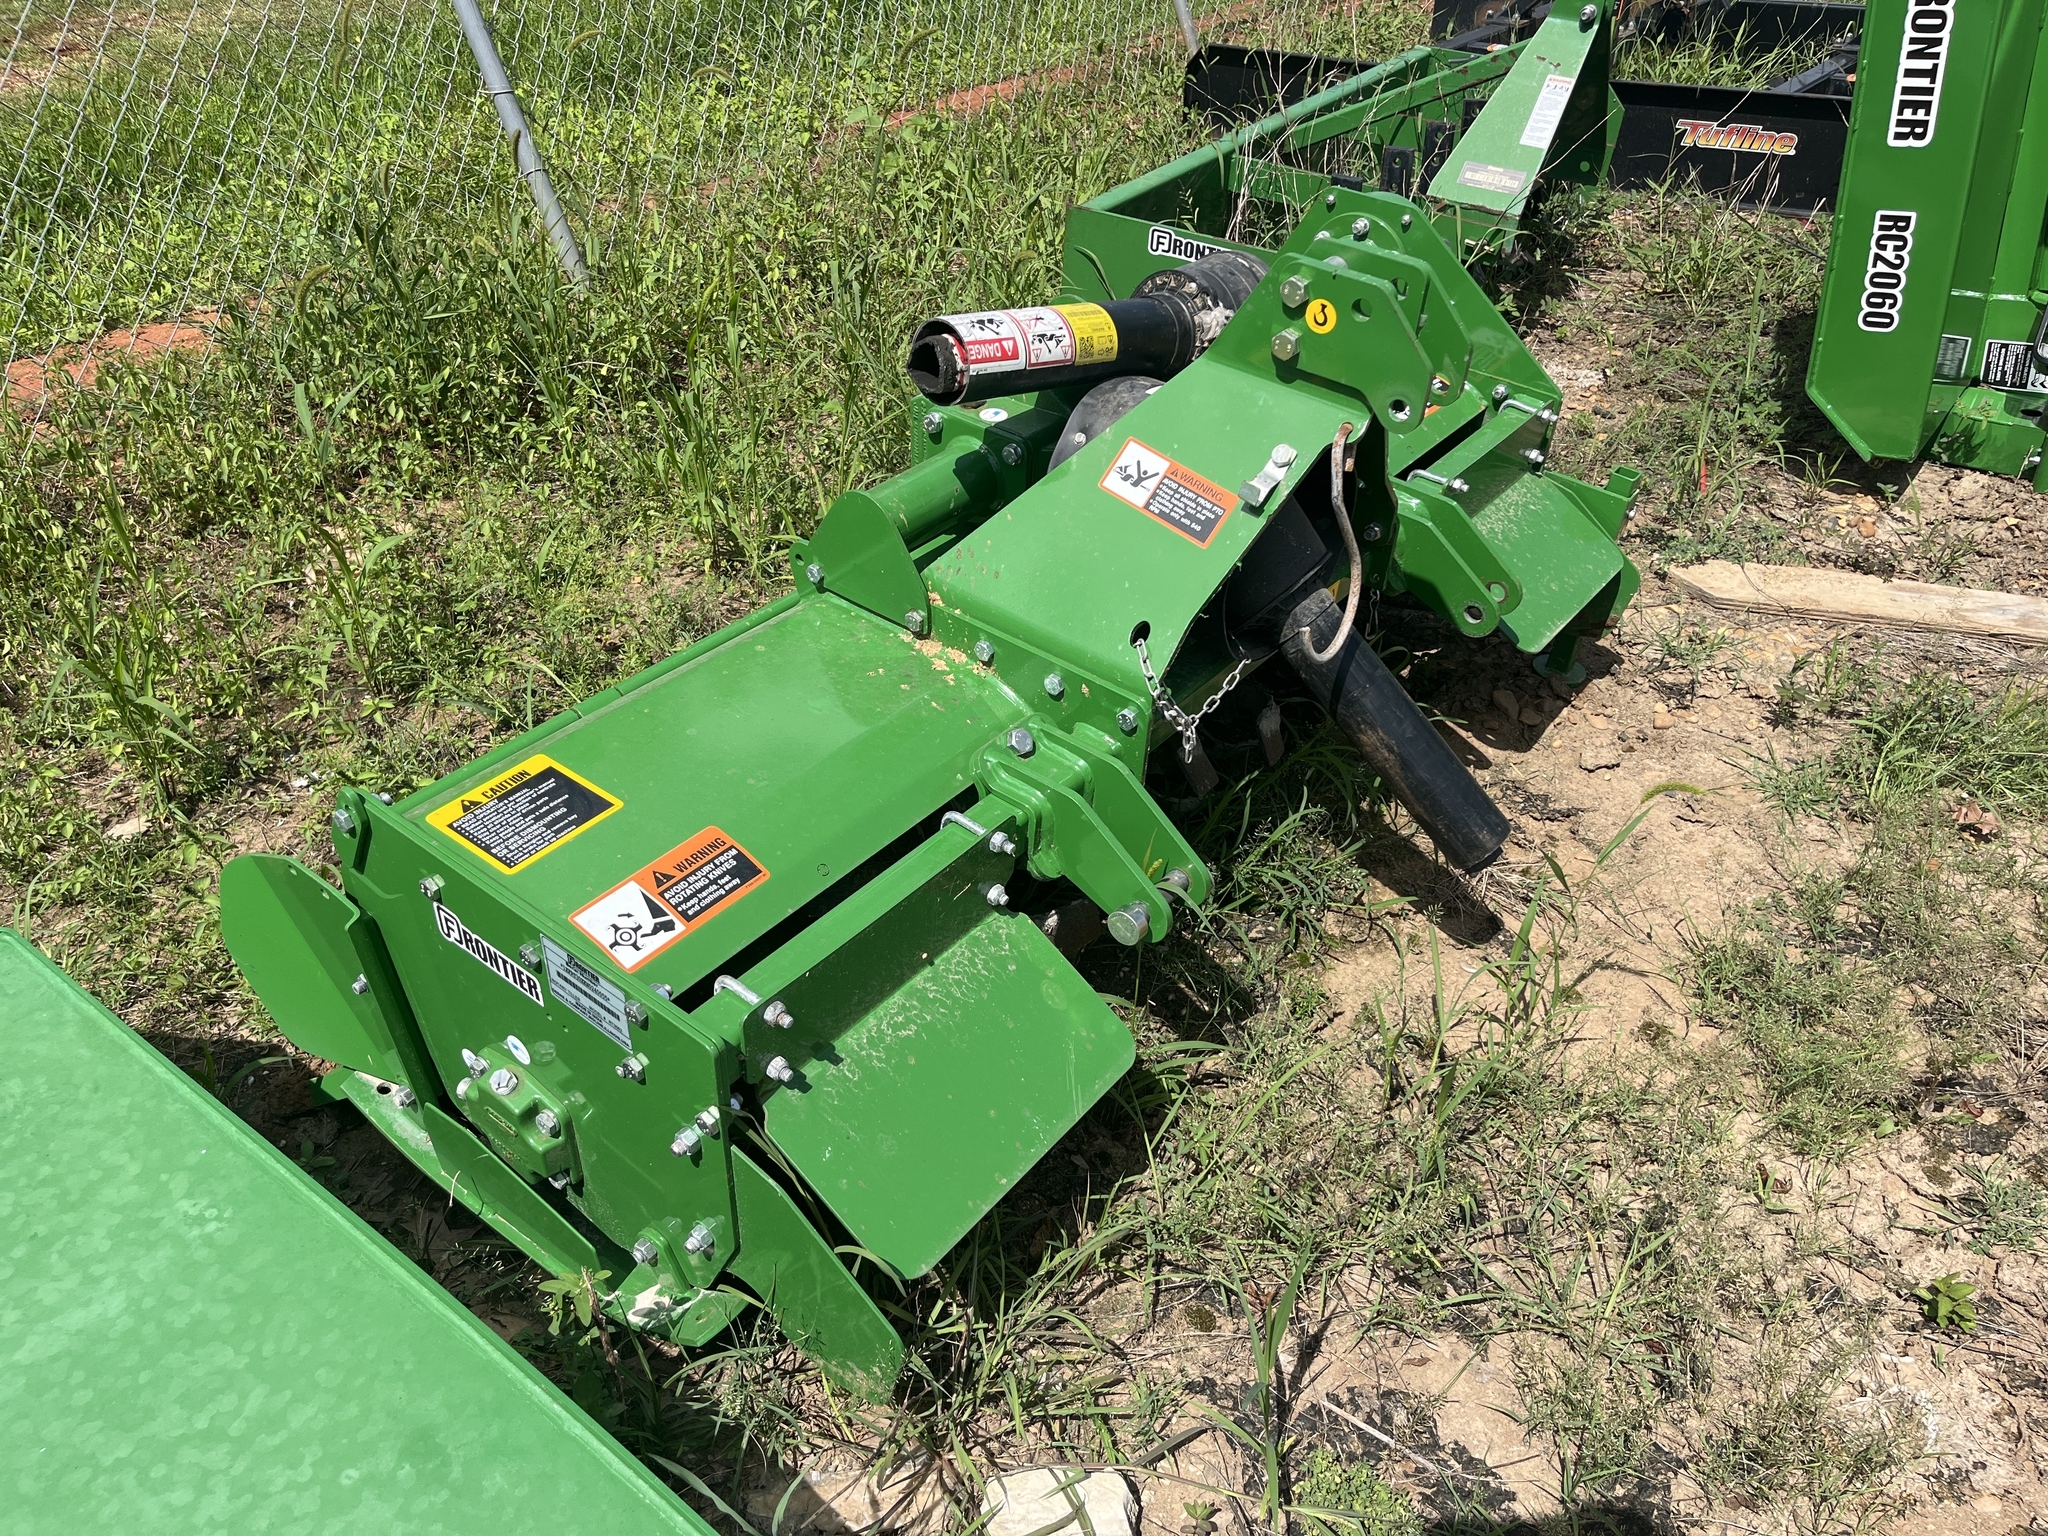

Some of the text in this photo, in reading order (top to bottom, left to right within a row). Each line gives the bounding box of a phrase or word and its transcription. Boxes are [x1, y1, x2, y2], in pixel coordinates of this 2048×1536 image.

[1893, 0, 1949, 141] ONTIER
[1677, 120, 1797, 154] Tufline
[1862, 213, 1913, 329] RC2060
[969, 342, 1002, 360] DANGE
[1162, 478, 1224, 515] AVOID INJURY FROM PTO
[1179, 473, 1224, 501] WARNING
[481, 770, 532, 799] CAUTION
[451, 800, 500, 827] AVOID INJURY
[490, 807, 568, 853] BEFORE DISMOUNTING
[496, 827, 547, 857] OR SERVICING
[673, 837, 727, 873] WARNING
[663, 848, 738, 899] AVOID INJURY FROM
[669, 859, 737, 905] ROTATING KNIVES
[681, 897, 699, 910] Keep
[697, 883, 719, 899] hands,
[718, 875, 731, 885] feet
[686, 904, 701, 916] and
[699, 888, 725, 907] clothing
[723, 877, 741, 891] away
[436, 904, 541, 1003] FRONTIER
